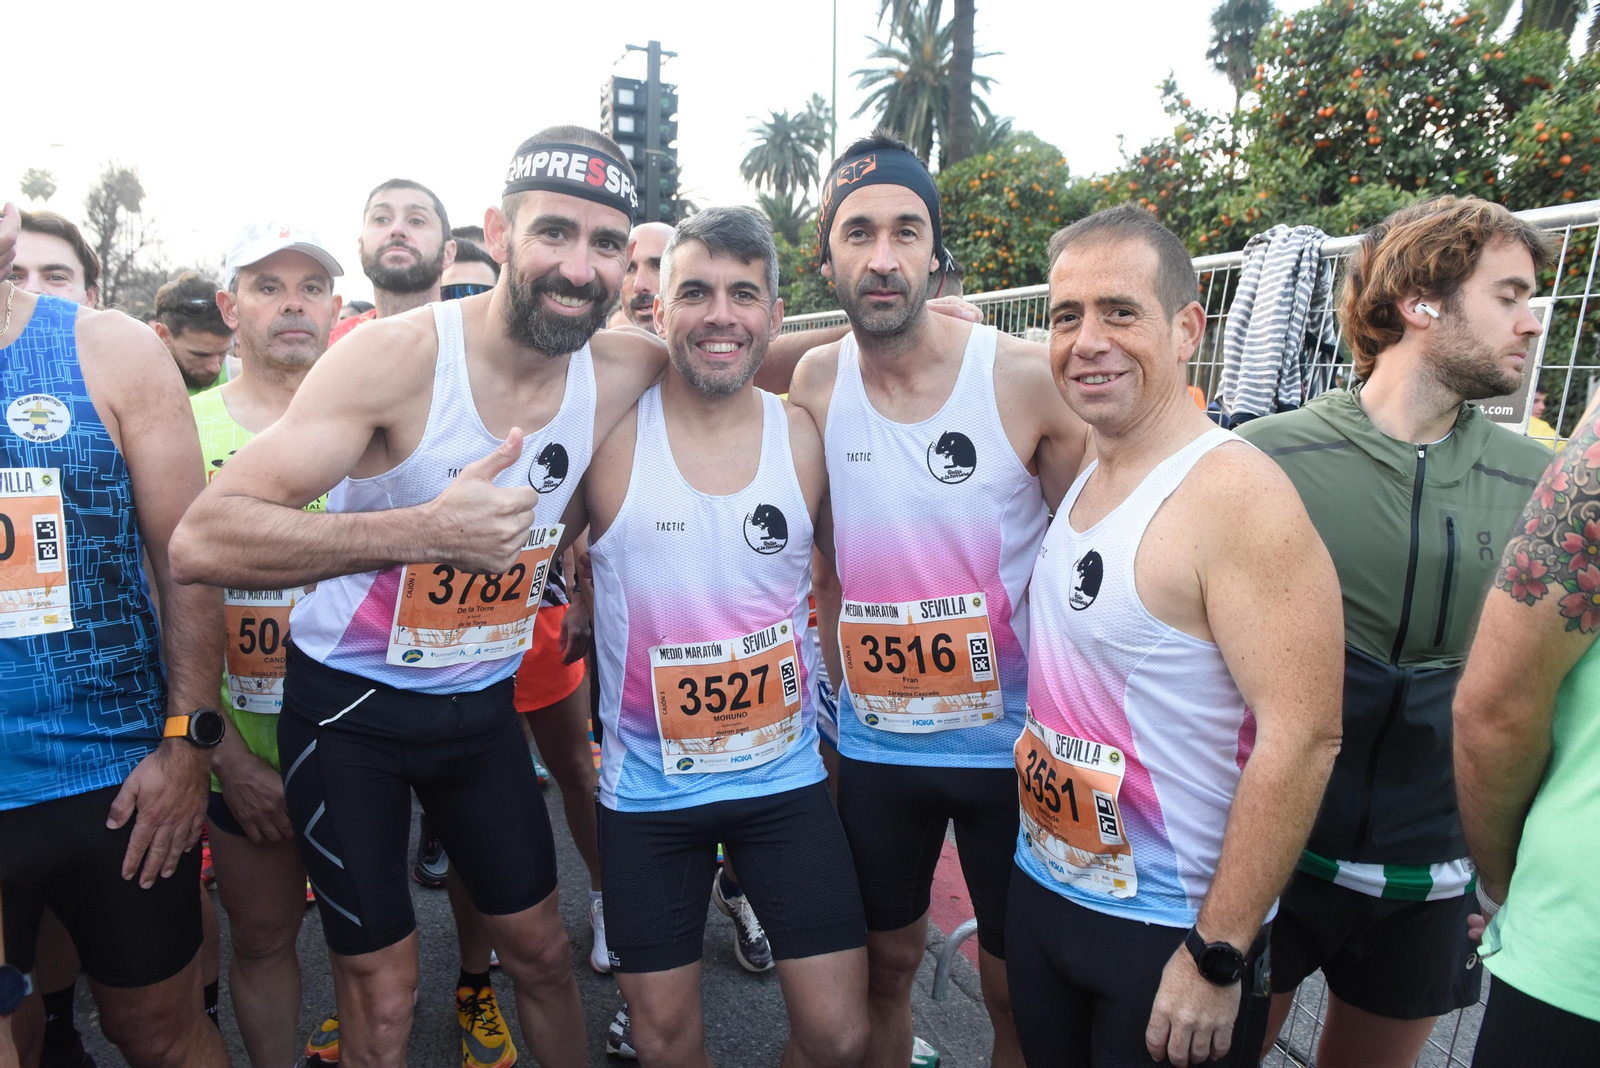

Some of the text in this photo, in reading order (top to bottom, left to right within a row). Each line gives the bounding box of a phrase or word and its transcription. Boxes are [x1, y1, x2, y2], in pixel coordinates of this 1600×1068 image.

[846, 452, 872, 462] TACTIC
[0, 472, 33, 493] ILLA
[656, 521, 686, 532] TACTIC
[406, 578, 415, 599] CAJÓN
[428, 563, 526, 605] 3782
[844, 596, 967, 619] MEDIO MARATÓN SEVILLA
[659, 626, 777, 661] MEDIO MARATÓN SEVILLA
[860, 633, 956, 674] 3516
[902, 676, 919, 684] Fran
[677, 664, 769, 716] 3527
[887, 690, 913, 698] Zaragoza
[713, 711, 748, 722] MORUNO
[912, 718, 935, 726] HOKA
[736, 726, 749, 734] paez
[731, 753, 753, 764] HOKA
[1055, 733, 1102, 766] SEVILLA
[1022, 749, 1080, 822] 3551
[1048, 859, 1065, 875] HOKA
